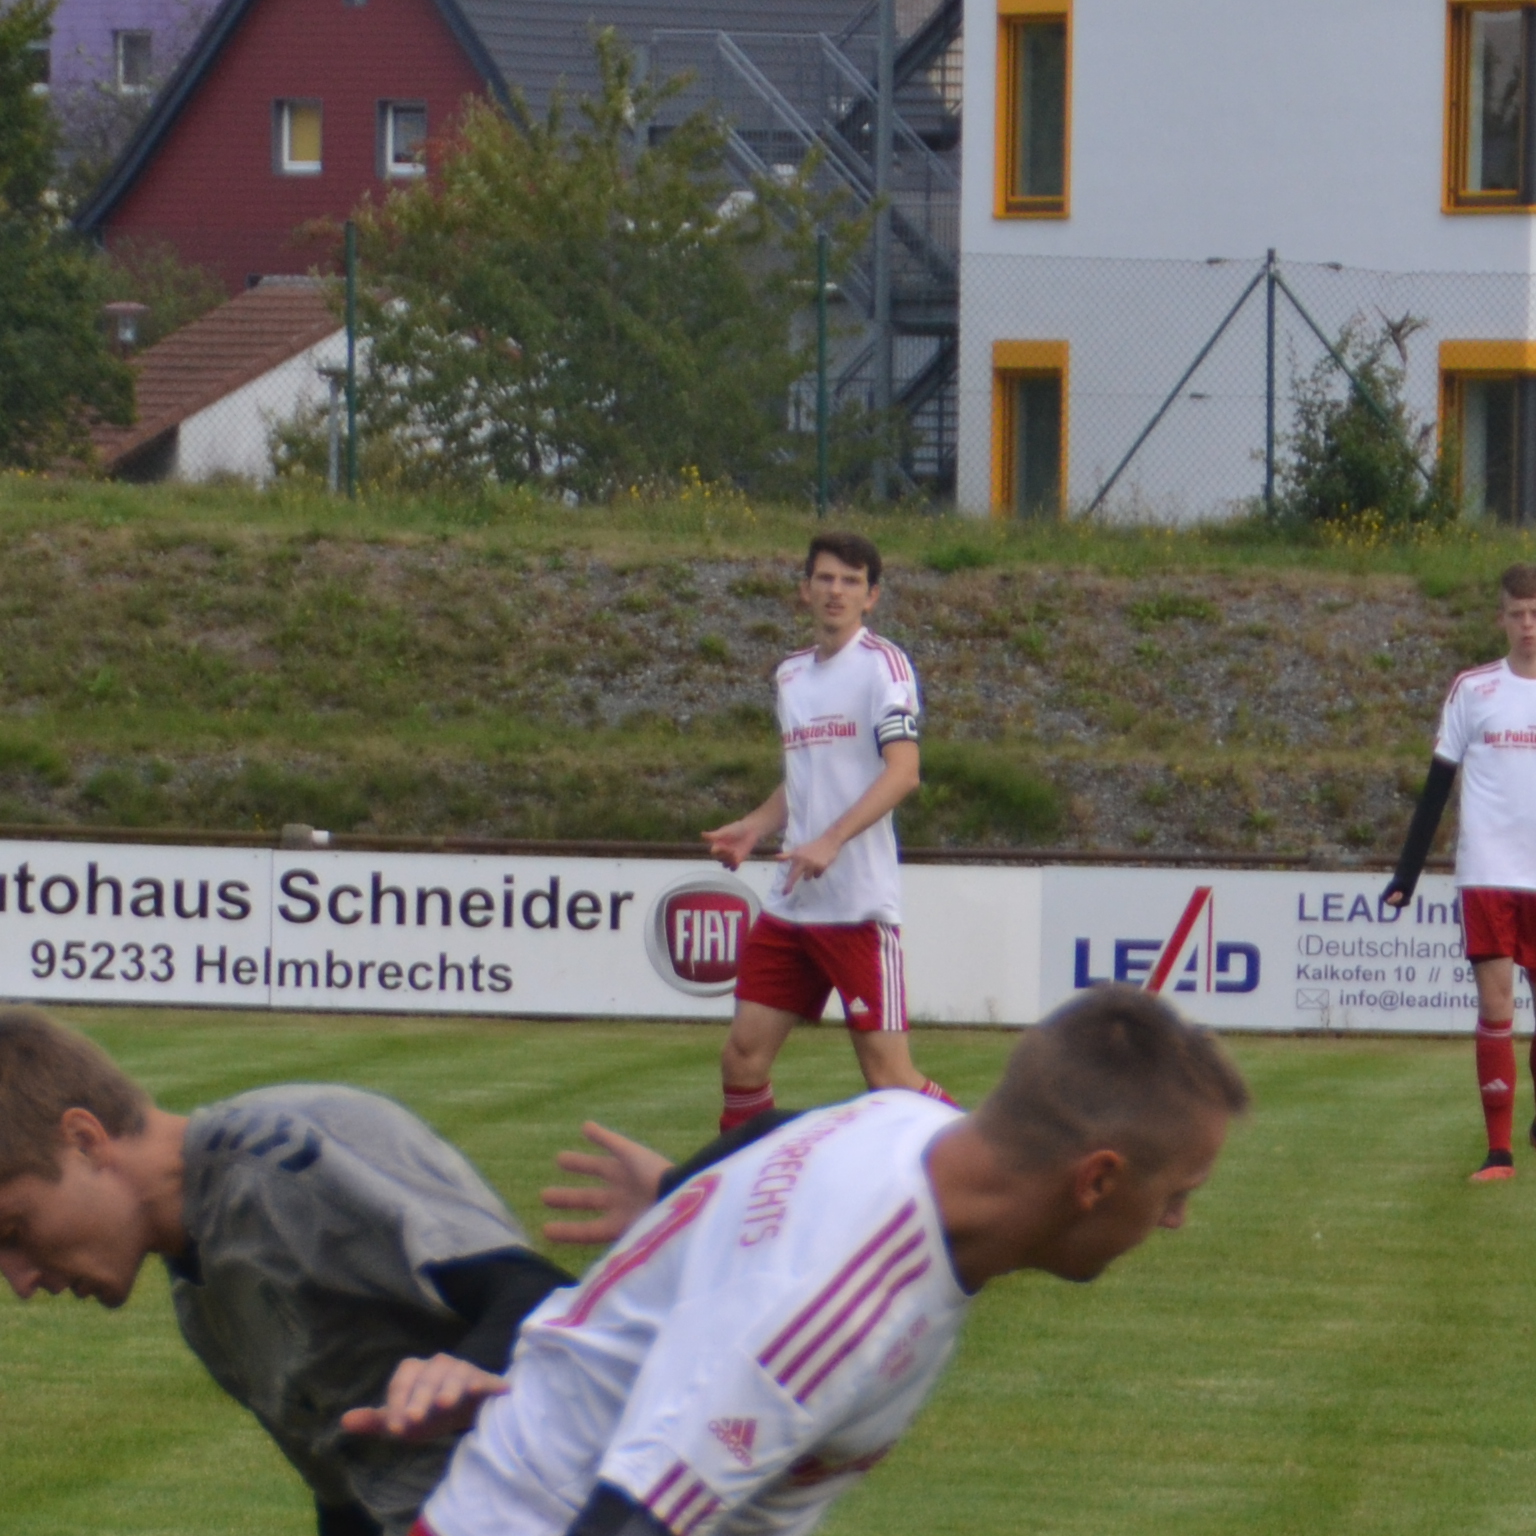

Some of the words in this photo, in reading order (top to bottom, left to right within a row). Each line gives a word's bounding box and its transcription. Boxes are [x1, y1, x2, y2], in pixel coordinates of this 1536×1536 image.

[277, 867, 635, 932] Schneider
[1297, 892, 1402, 924] LEAD
[674, 907, 743, 965] FIAT
[1073, 885, 1262, 994] LEAD
[30, 939, 175, 984] 95233
[194, 943, 514, 994] Helmbrechts
[1296, 963, 1386, 982] Kalkofen
[1394, 965, 1416, 982] 10
